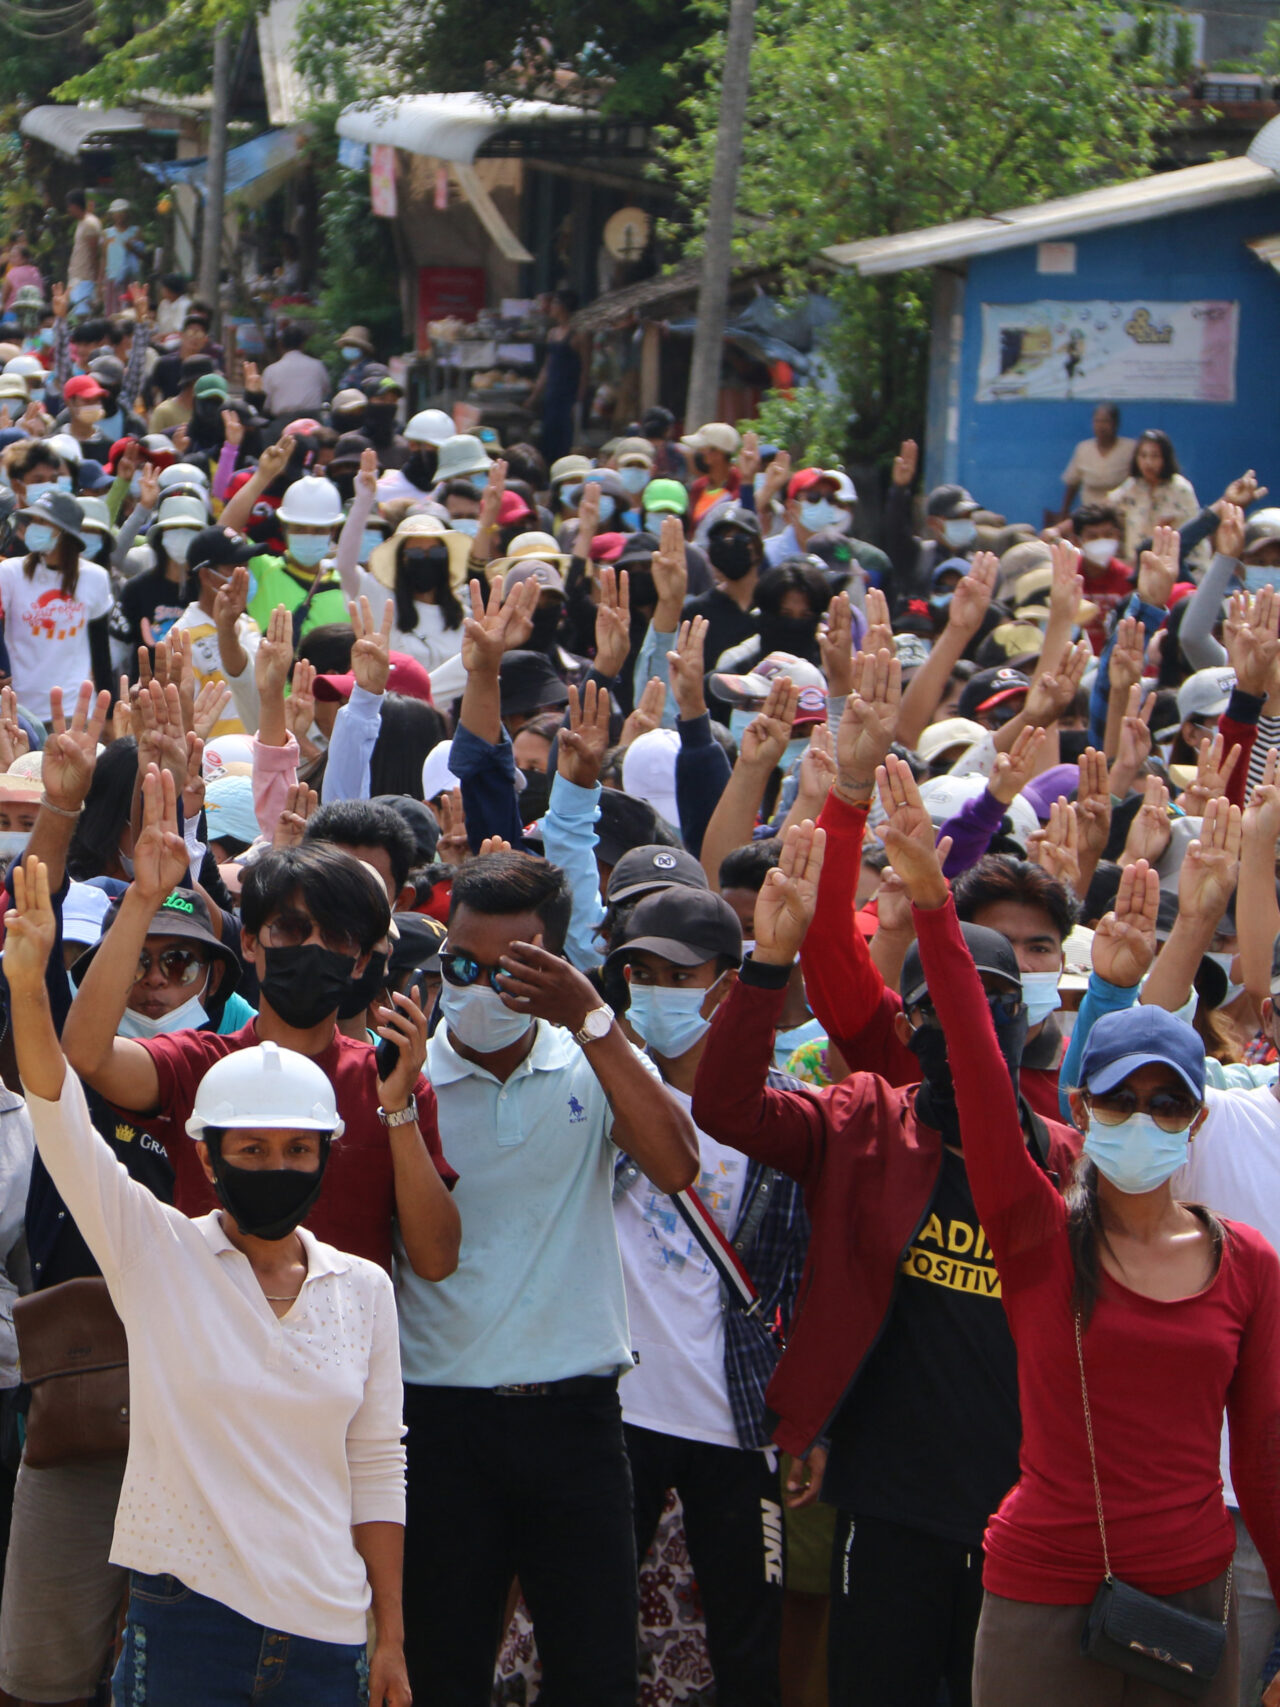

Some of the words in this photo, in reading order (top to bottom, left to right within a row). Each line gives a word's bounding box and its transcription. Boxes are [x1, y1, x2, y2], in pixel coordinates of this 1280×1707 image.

[163, 891, 194, 914] das
[918, 1213, 994, 1260] ADI
[760, 1497, 783, 1586] NIKE
